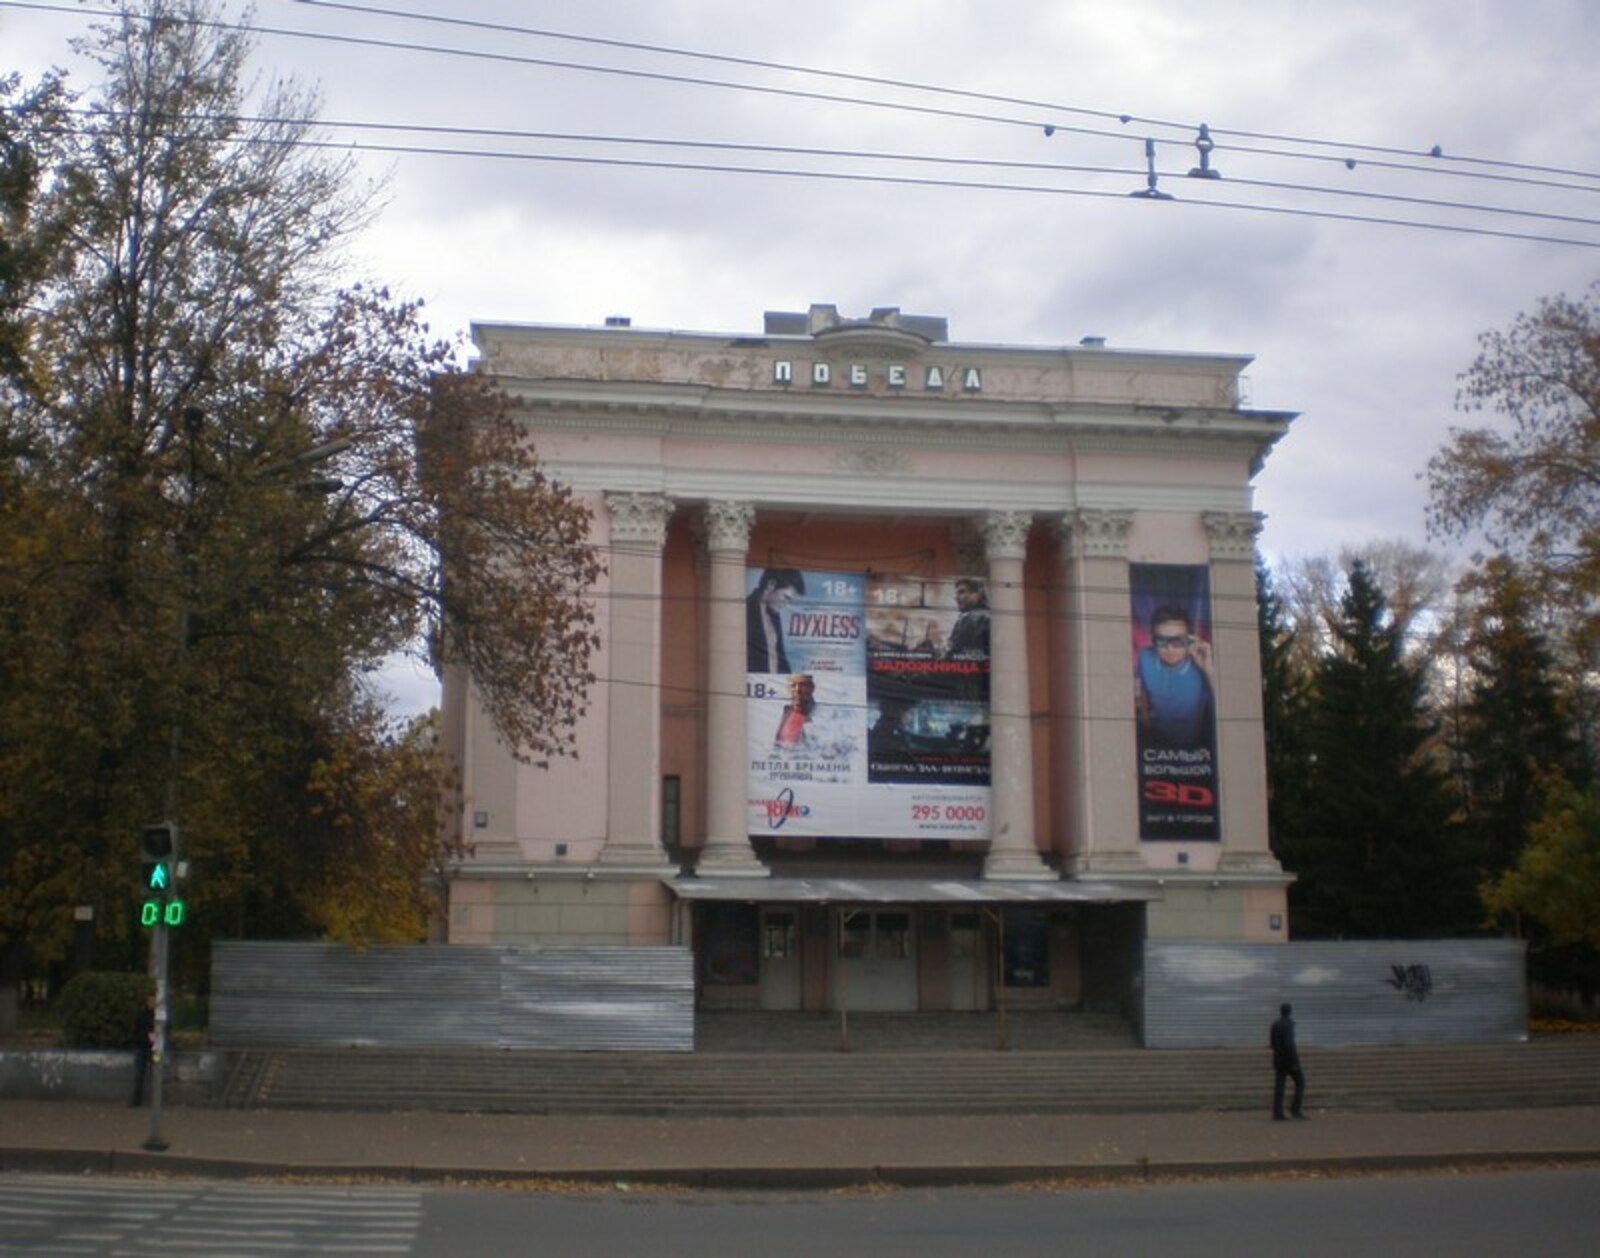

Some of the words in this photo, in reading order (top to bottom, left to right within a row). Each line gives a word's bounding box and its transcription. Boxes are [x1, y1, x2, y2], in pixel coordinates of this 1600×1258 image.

[775, 361, 980, 388] ПОБЕДА
[822, 580, 857, 596] 18+
[1144, 781, 1214, 807] 3D
[912, 804, 941, 821] 295
[945, 805, 985, 822] 0000
